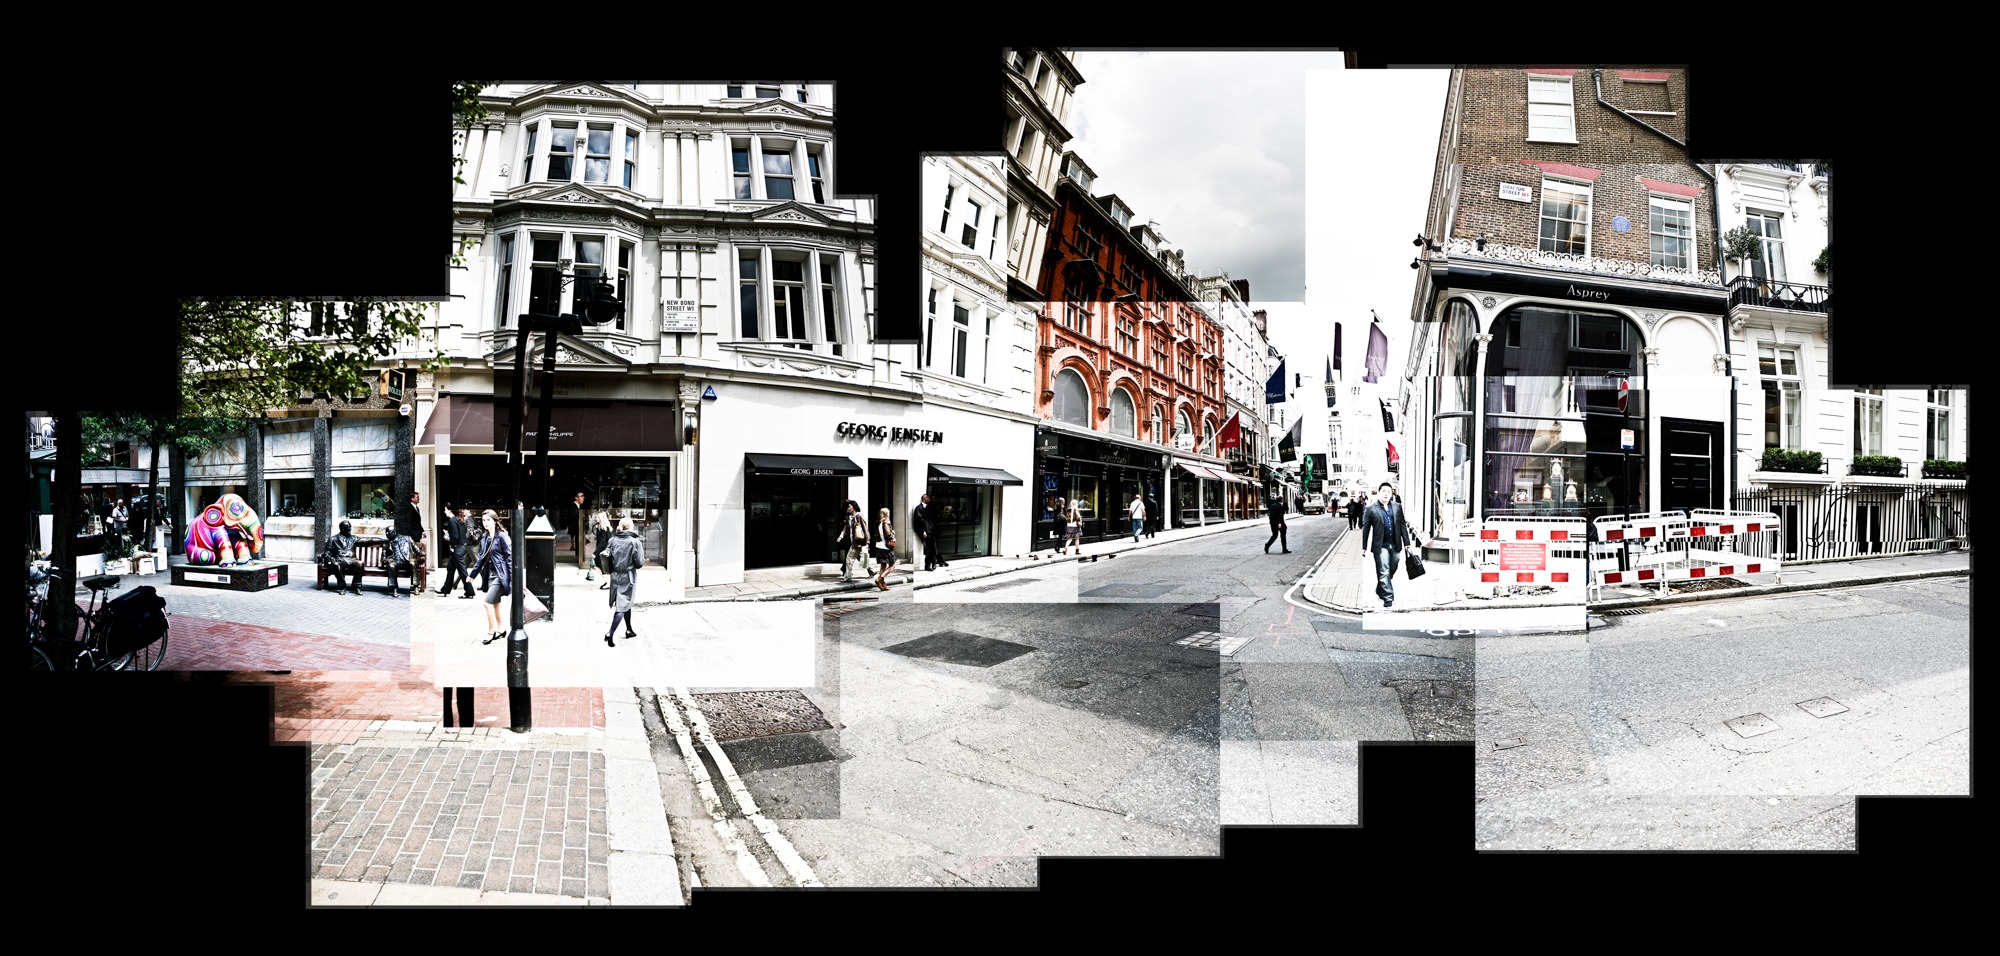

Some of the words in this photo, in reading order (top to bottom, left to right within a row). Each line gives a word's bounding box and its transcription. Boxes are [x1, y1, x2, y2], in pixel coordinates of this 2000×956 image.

[1566, 284, 1611, 302] Asprey
[388, 385, 402, 397] ROLEX
[837, 421, 888, 440] GEORG
